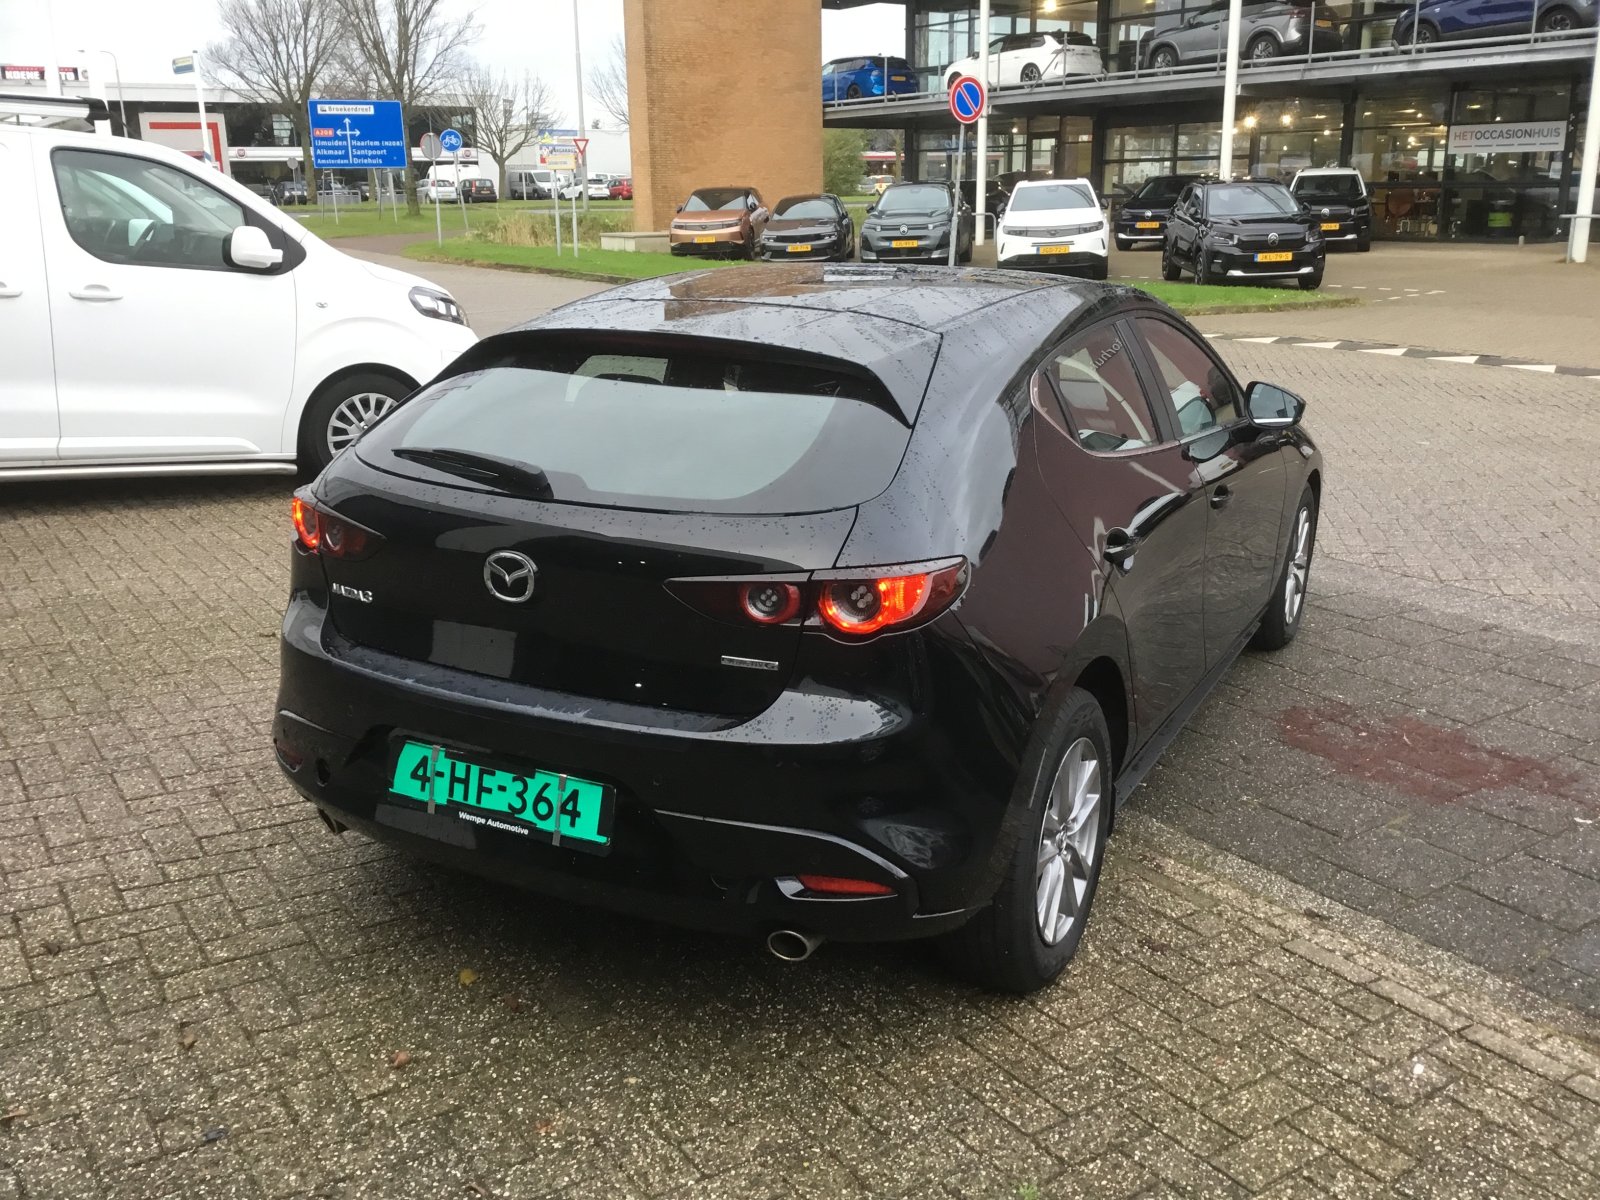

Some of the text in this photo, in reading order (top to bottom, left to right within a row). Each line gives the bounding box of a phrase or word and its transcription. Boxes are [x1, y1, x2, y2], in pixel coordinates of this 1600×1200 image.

[328, 105, 371, 113] Broekerdreef
[1454, 127, 1561, 141] HETOCCASIONHUIS
[352, 149, 387, 157] Santpoort
[410, 755, 581, 828] 4-HF-364
[458, 810, 529, 835] Wempe Automotive
